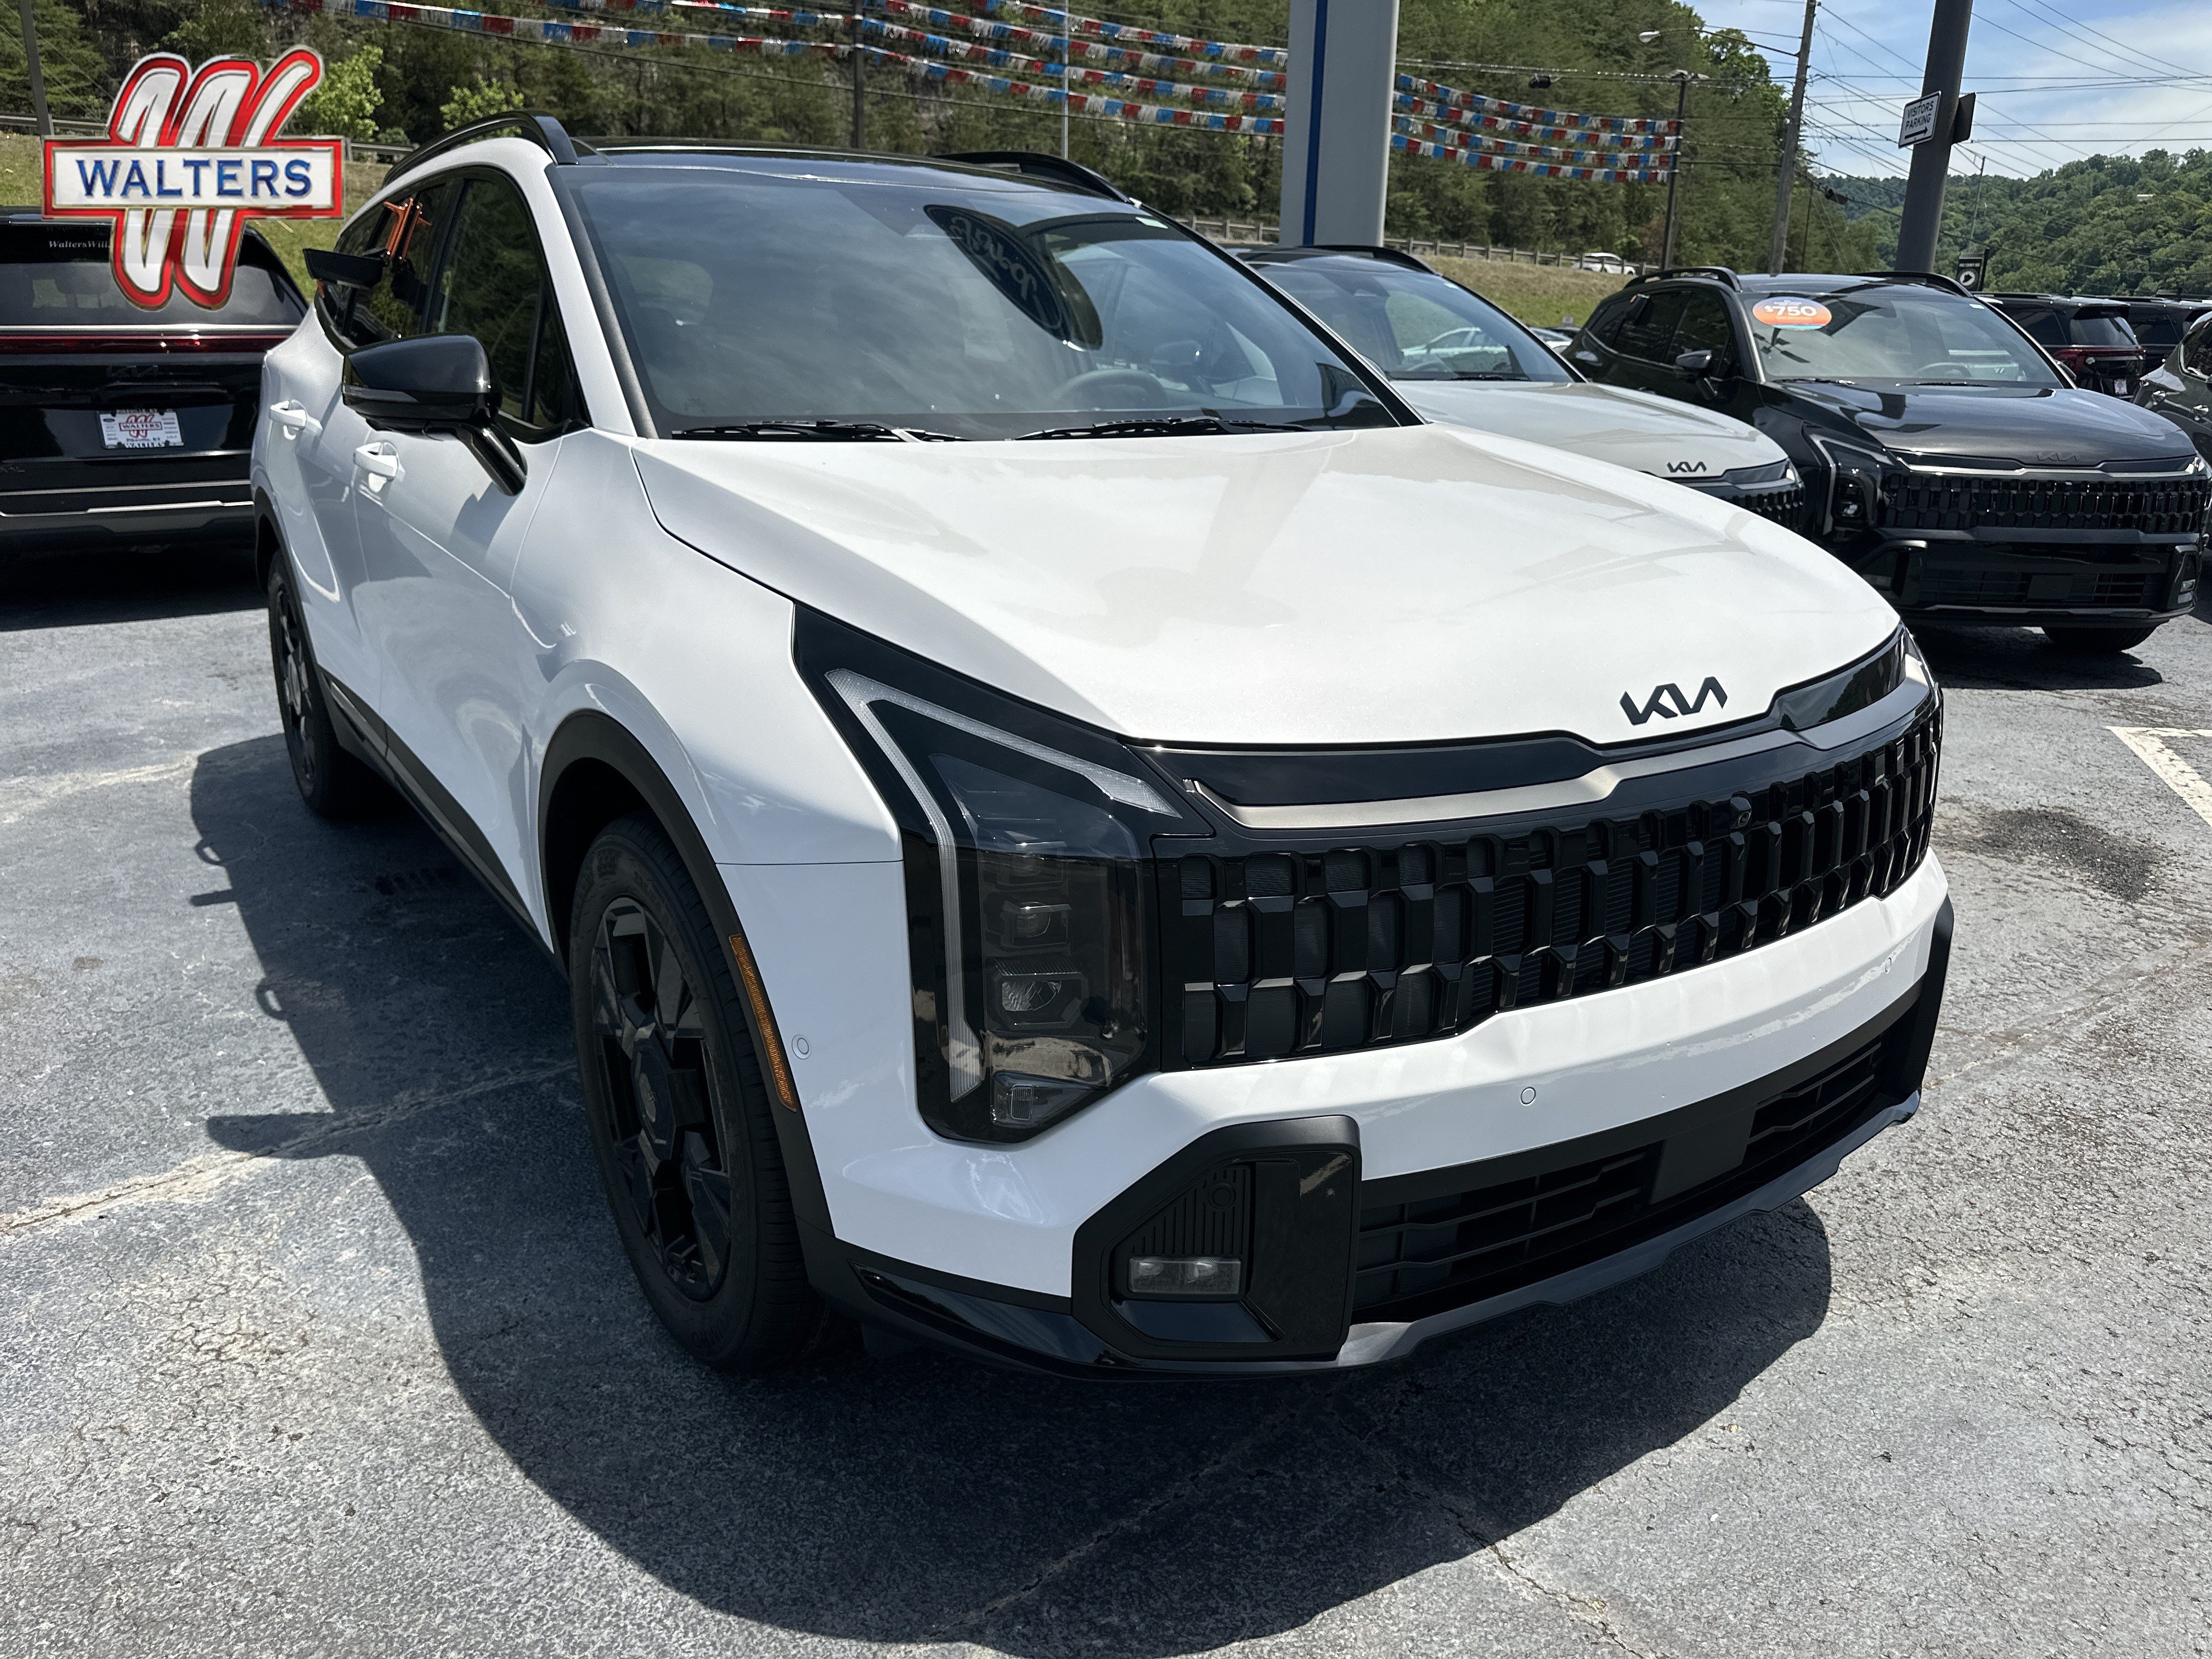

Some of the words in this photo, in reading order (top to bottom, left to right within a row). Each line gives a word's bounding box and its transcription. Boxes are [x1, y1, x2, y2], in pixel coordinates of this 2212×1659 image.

[1908, 101, 1934, 119] VISITORS
[1905, 114, 1931, 131] PARKING
[1764, 305, 1818, 317] $750
[2036, 452, 2079, 462] KIA
[1667, 461, 1707, 473] KIA
[1620, 676, 1728, 726] KIA
